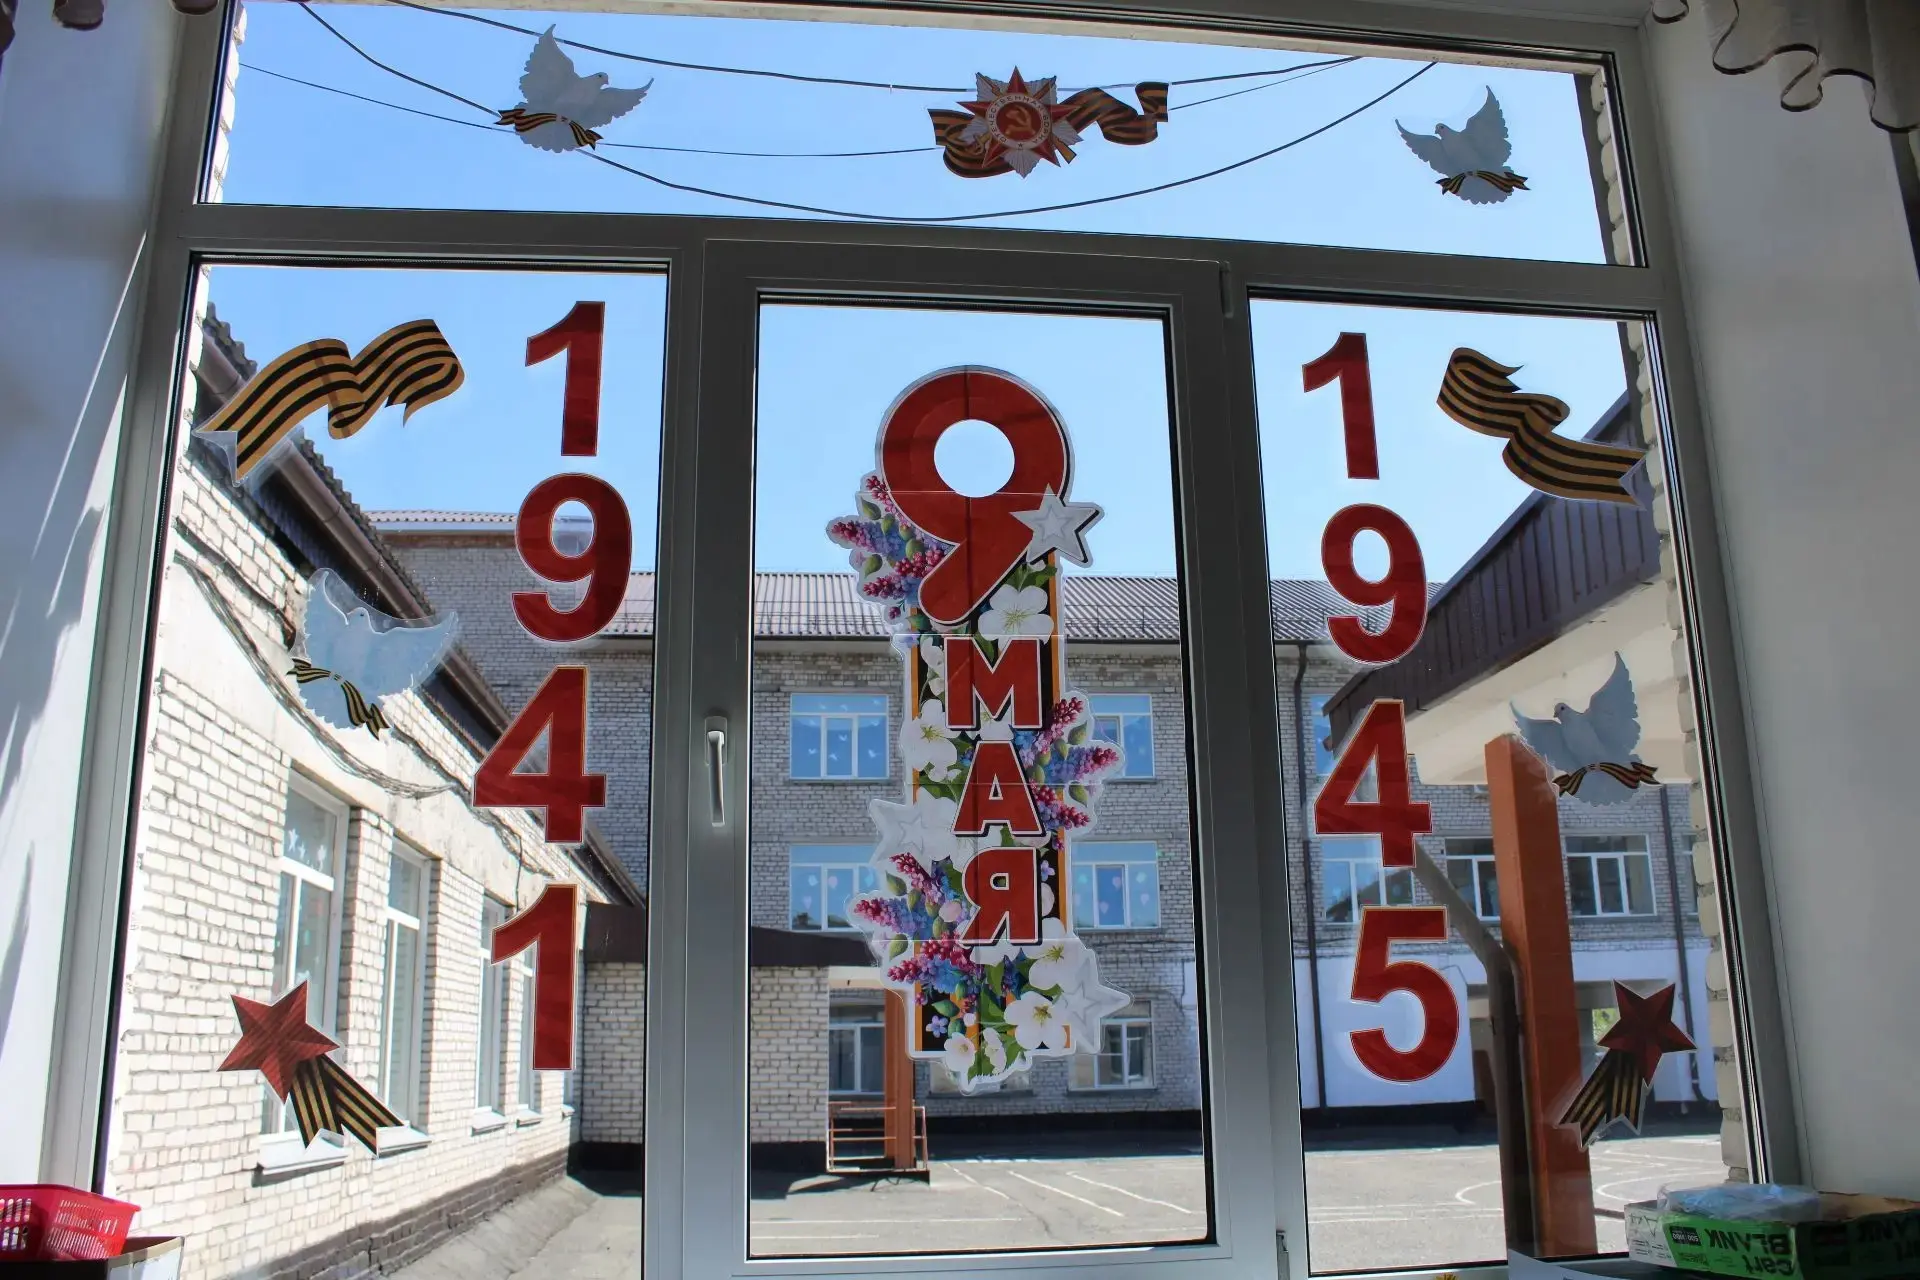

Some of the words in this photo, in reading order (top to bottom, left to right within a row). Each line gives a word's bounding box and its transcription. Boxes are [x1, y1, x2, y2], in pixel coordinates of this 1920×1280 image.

[989, 95, 1044, 143] ОТЕЧЕСТВЕННАЯ
[882, 370, 1067, 625] 9
[944, 637, 1043, 945] МАЯ
[1704, 1228, 1791, 1255] BLANK
